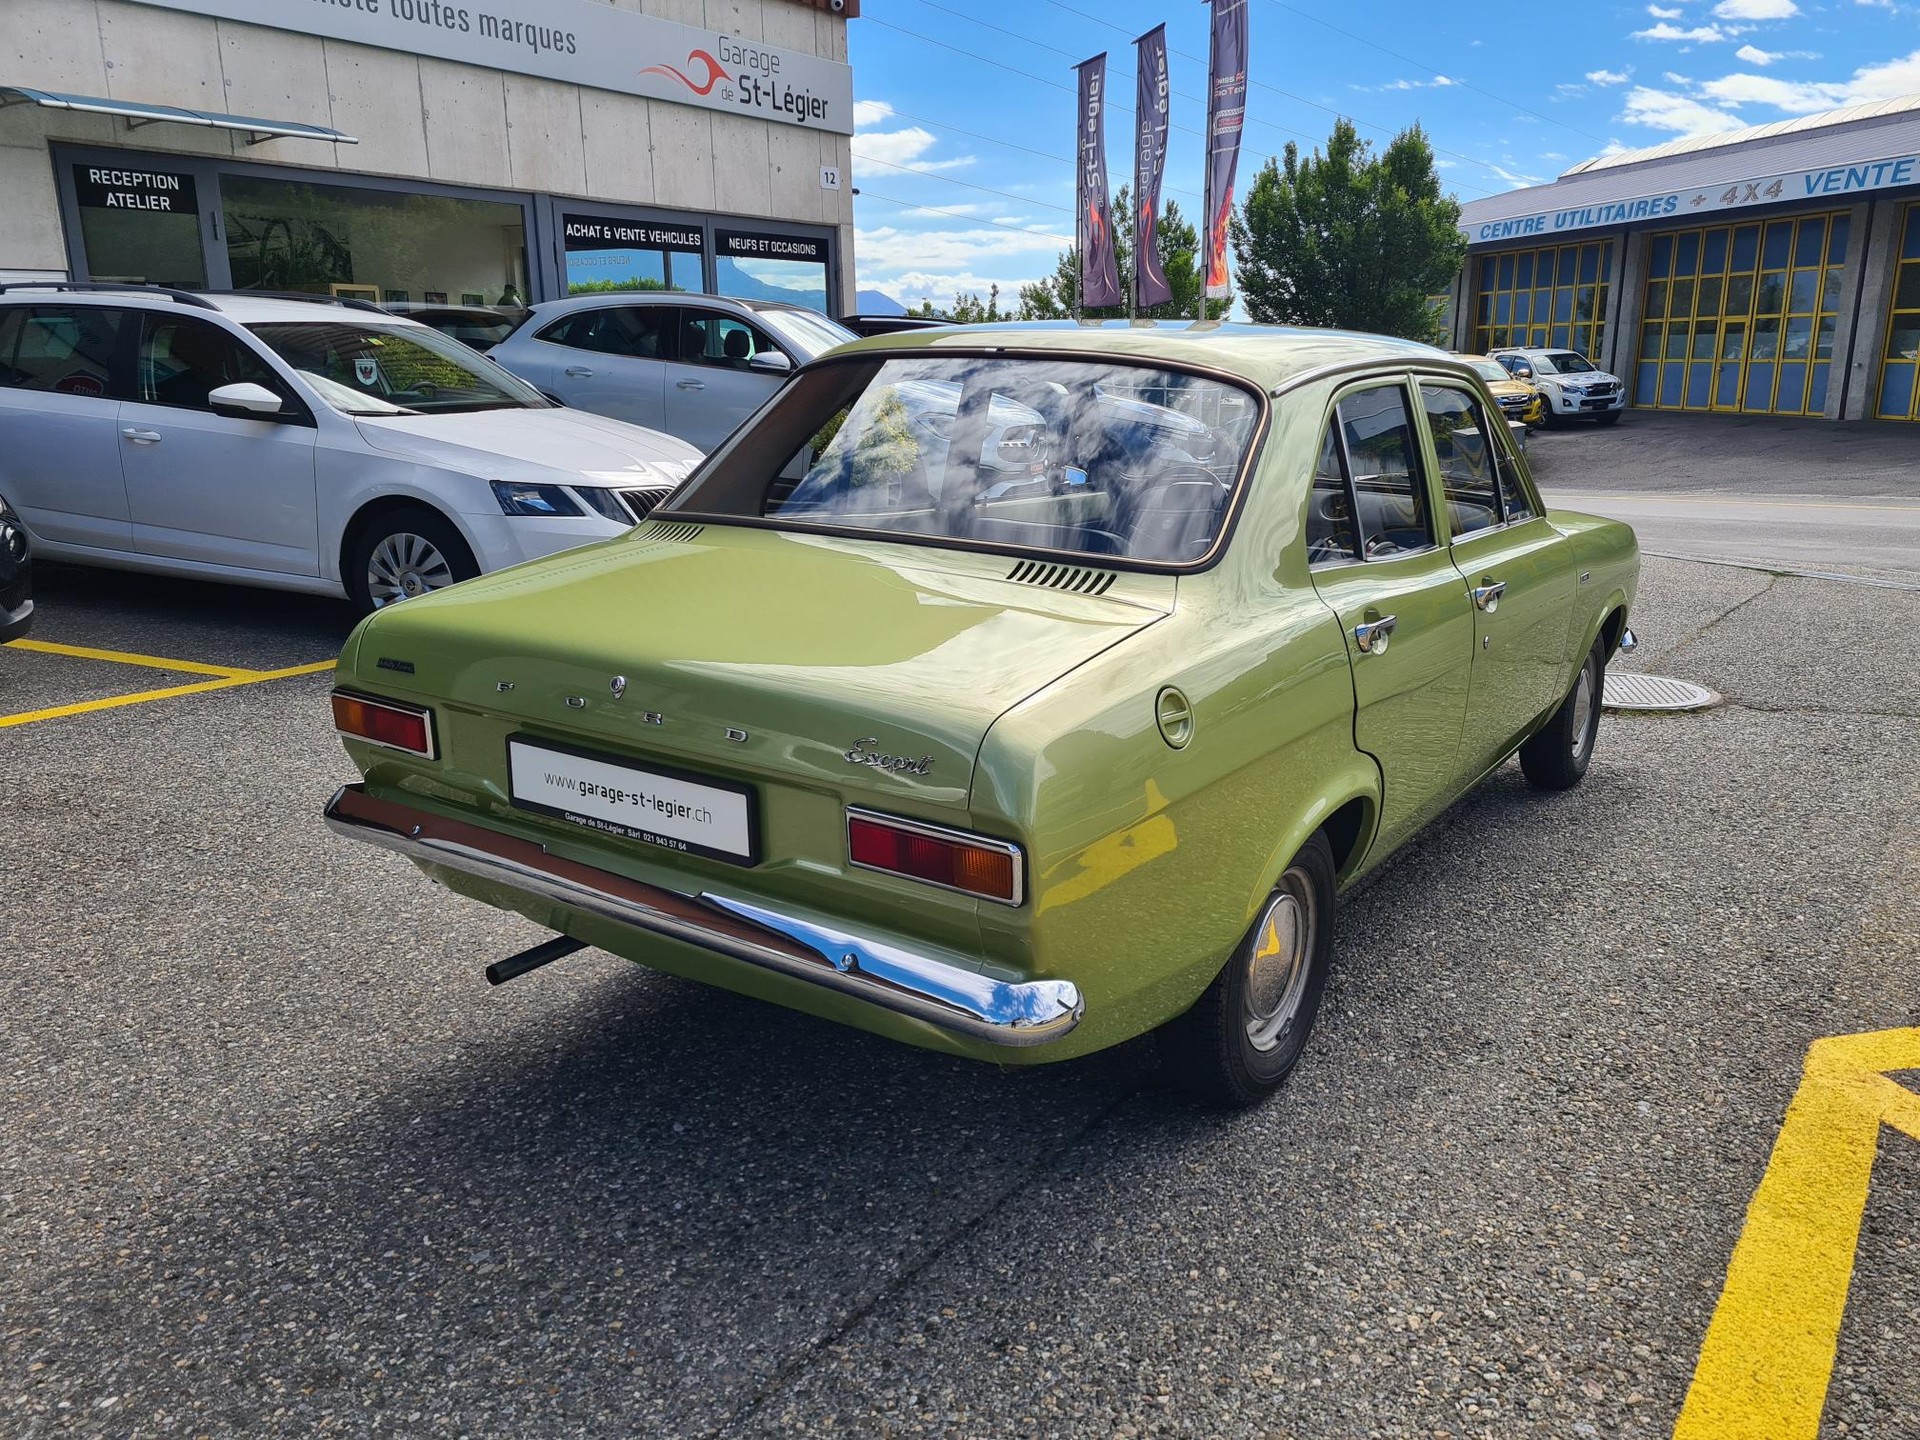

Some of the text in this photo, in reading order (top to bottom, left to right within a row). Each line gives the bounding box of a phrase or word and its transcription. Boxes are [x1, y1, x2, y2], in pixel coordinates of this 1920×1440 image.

[390, 0, 577, 54] toutes marques
[718, 36, 780, 77] Garage
[721, 74, 829, 123] de St-Légier
[89, 168, 180, 190] RECEPTION
[824, 171, 836, 185] 12
[106, 192, 171, 211] ATELIER
[1480, 215, 1546, 239] CENTRE
[1554, 195, 1679, 229] UTILITAIRES
[1804, 158, 1916, 195] VENTE
[566, 223, 701, 246] ACHAT & VENTE VEHICULES
[728, 237, 817, 255] NEUFS ET OCCASIONS
[844, 737, 935, 775] Escort
[544, 772, 712, 824] www.garage-st-legier.ch
[564, 811, 587, 826] Garage
[587, 818, 596, 828] de
[596, 820, 625, 836] St-Légier
[643, 832, 655, 843] 021
[655, 836, 669, 847] 943
[668, 839, 678, 849] 57
[678, 842, 687, 851] 64
